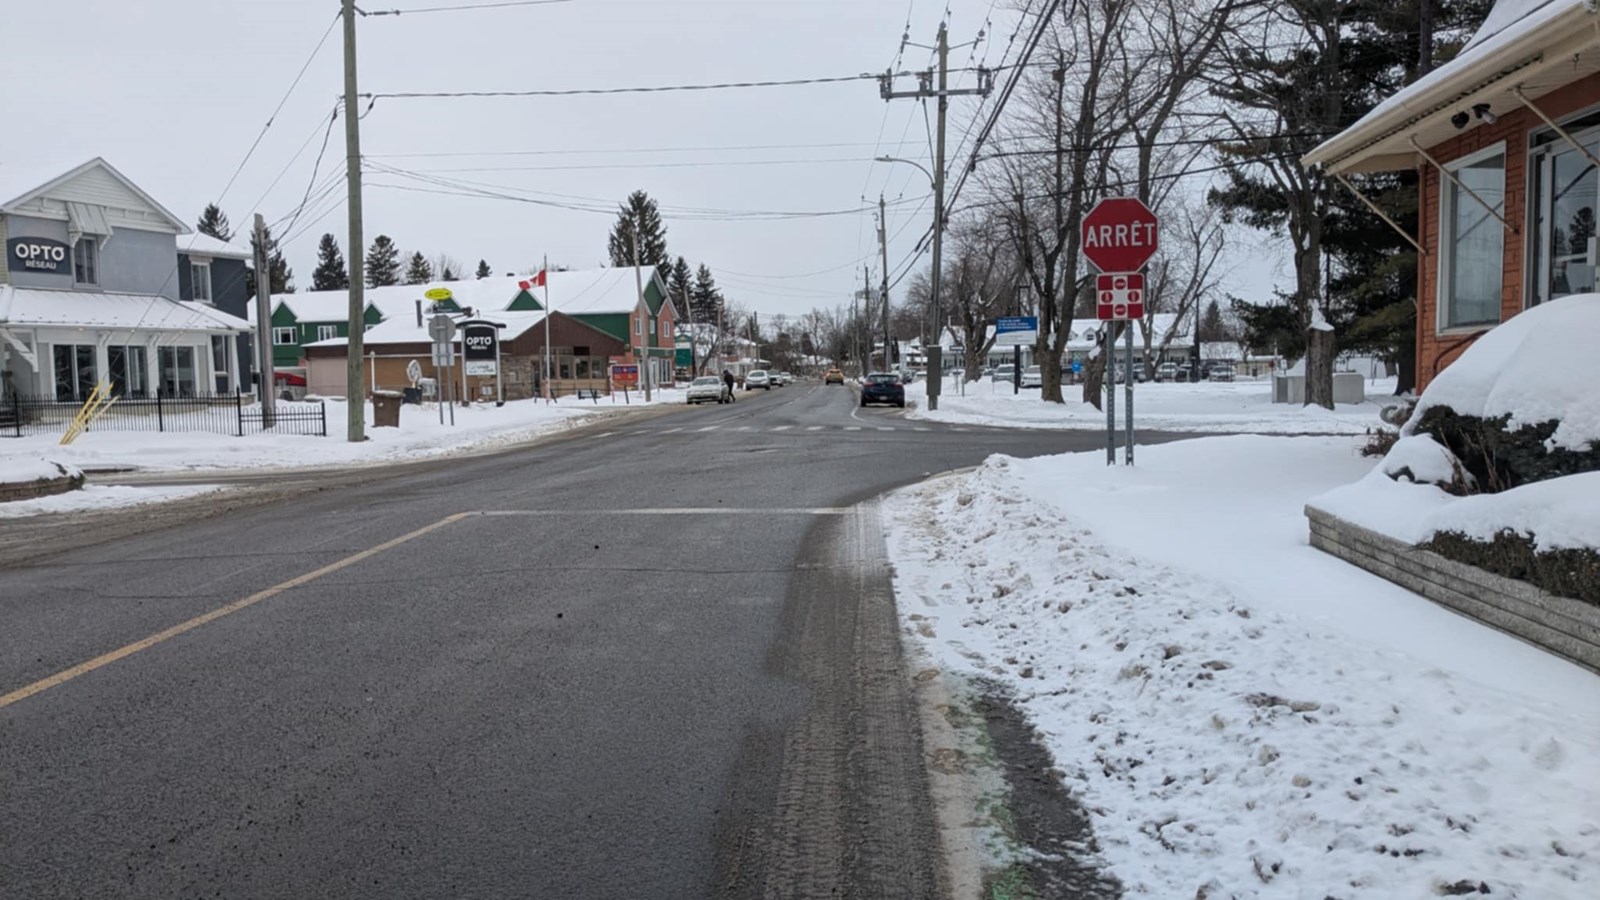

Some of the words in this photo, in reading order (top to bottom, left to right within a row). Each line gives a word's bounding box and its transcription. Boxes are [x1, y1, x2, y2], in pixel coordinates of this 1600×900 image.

[1085, 220, 1155, 248] ARRÊT
[15, 243, 65, 261] OPTO
[466, 336, 492, 345] OPTO
